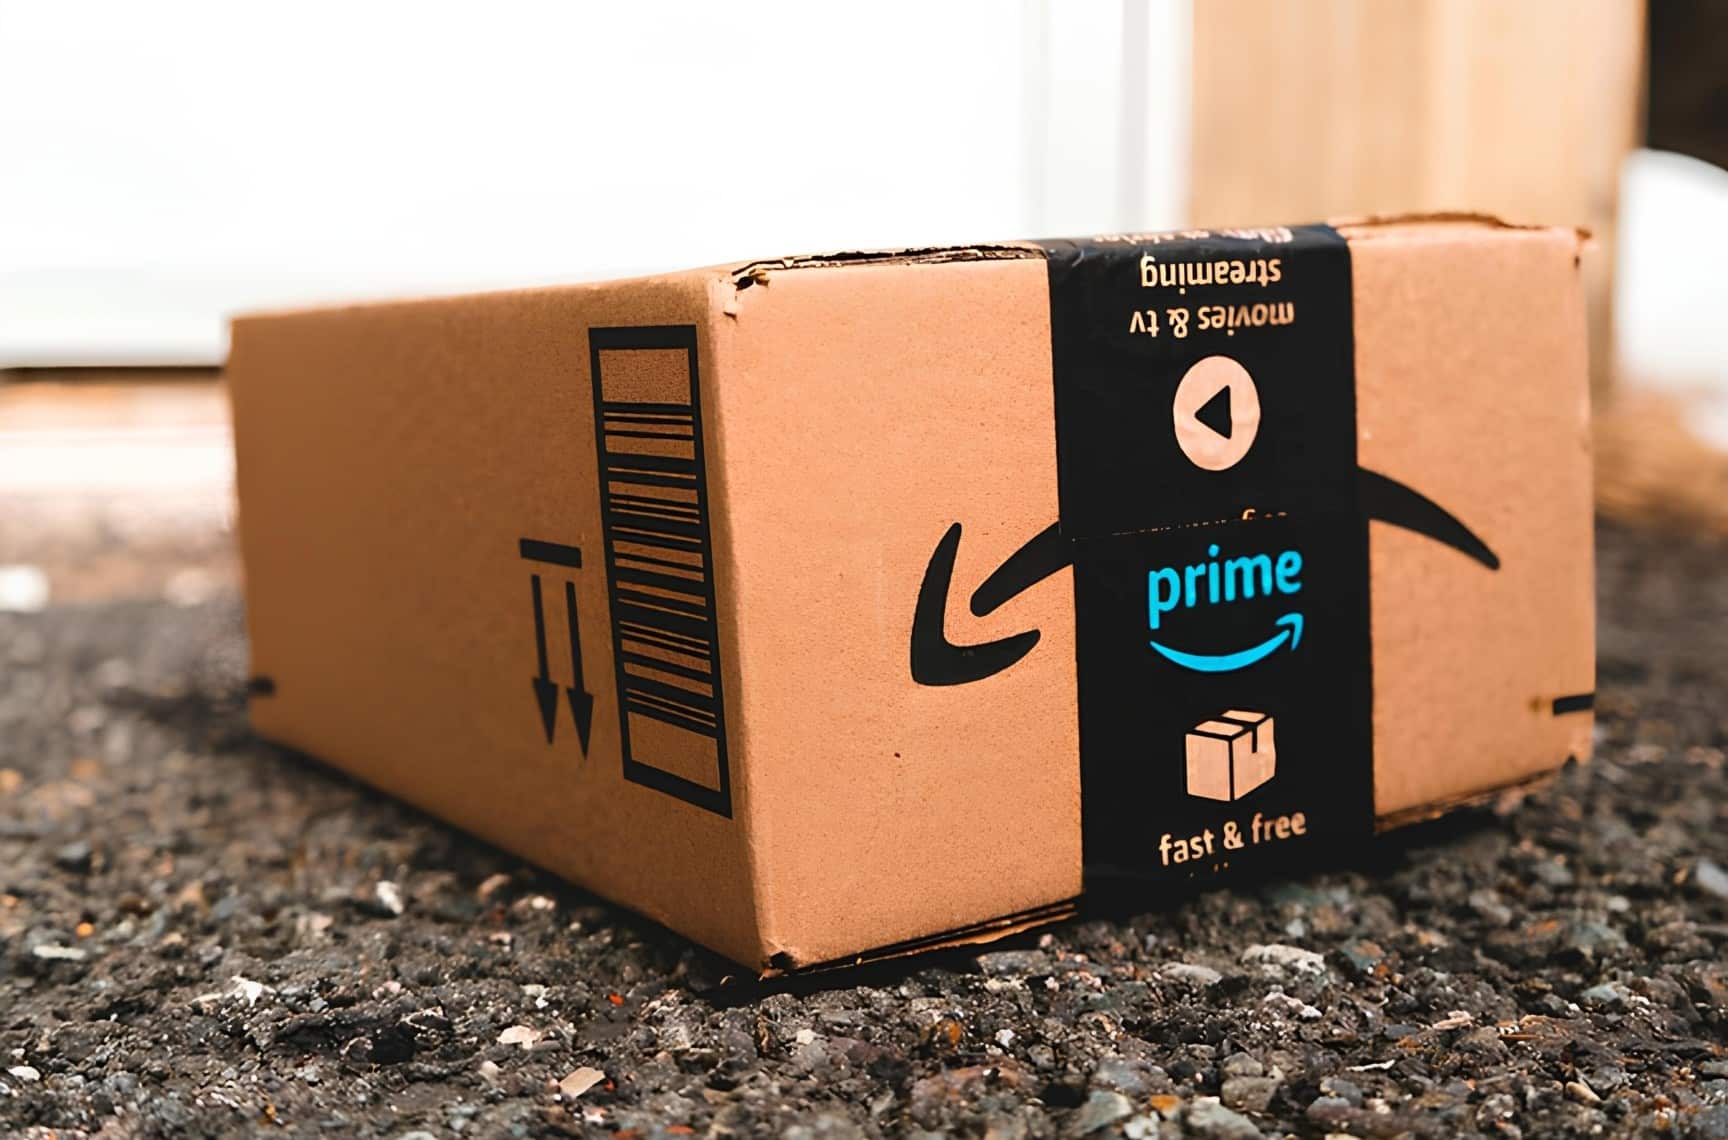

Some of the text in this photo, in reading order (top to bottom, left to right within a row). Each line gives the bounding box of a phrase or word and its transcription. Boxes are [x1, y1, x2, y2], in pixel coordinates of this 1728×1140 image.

[1140, 255, 1282, 294] streaming
[1129, 302, 1295, 338] movies & tv
[1148, 544, 1303, 630] prime
[1158, 811, 1307, 866] fast & free
